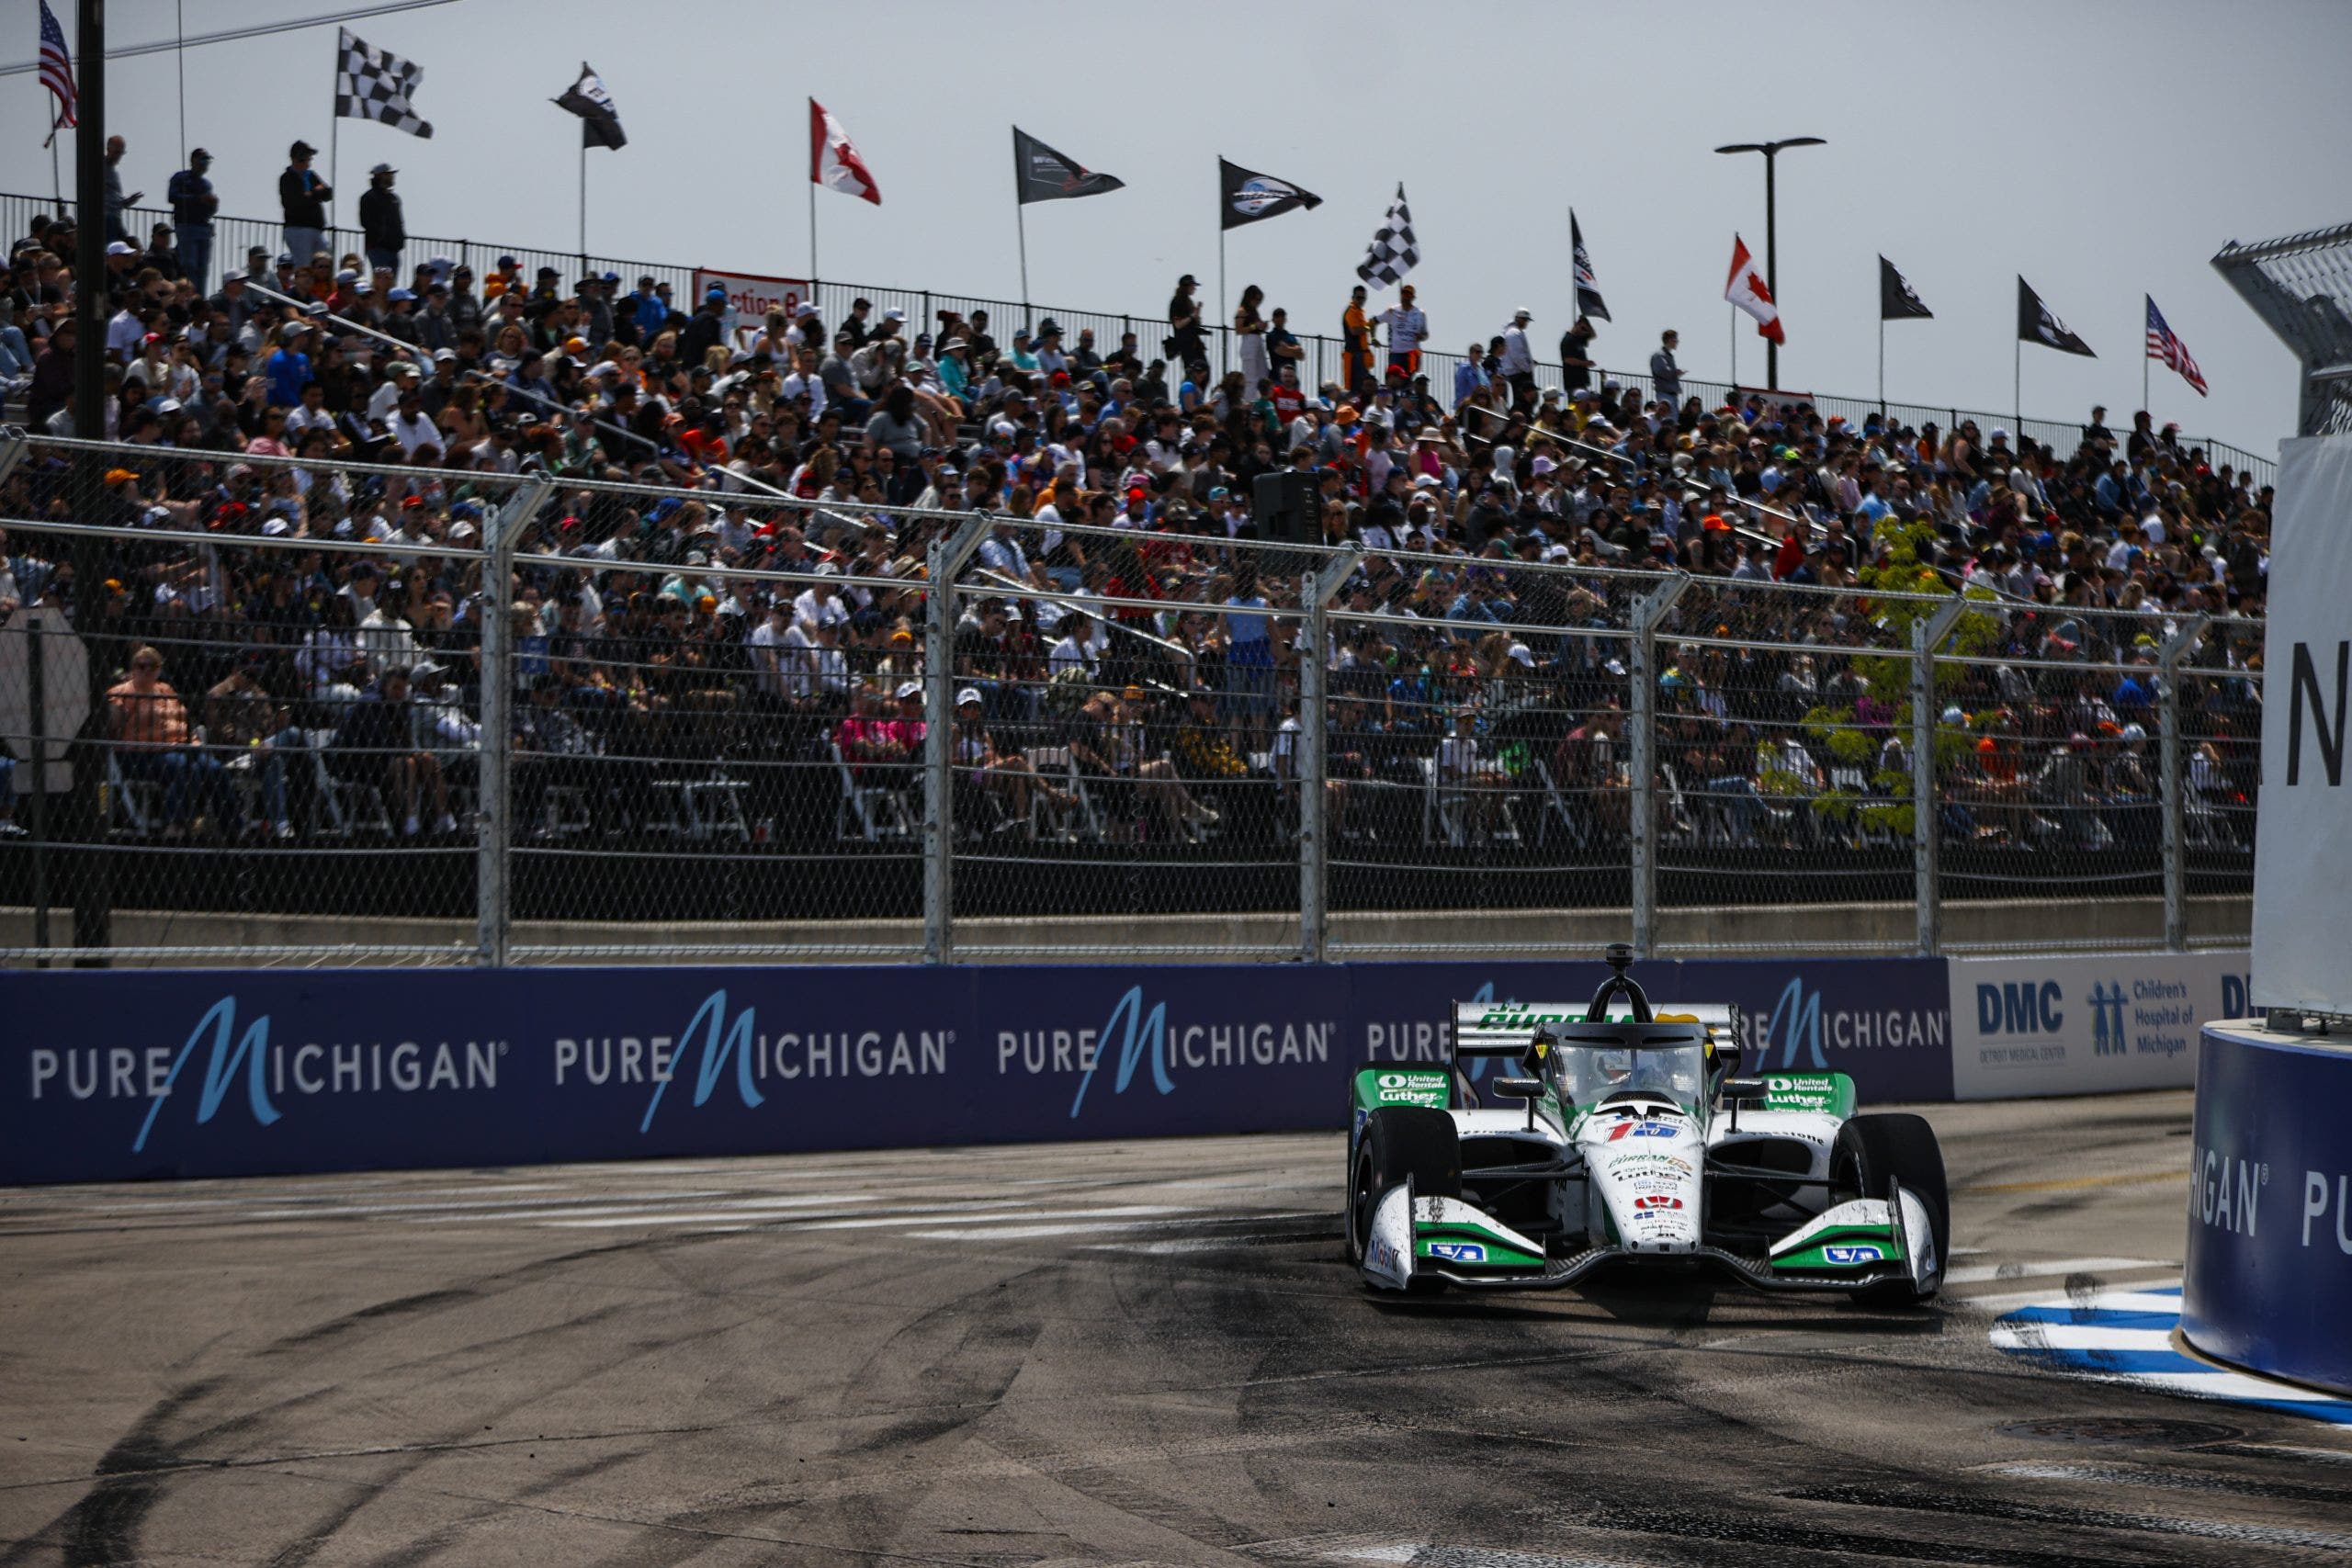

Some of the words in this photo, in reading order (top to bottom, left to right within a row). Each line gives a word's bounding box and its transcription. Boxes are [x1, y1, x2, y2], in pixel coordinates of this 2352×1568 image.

[2287, 641, 2349, 786] N
[1977, 978, 2064, 1035] DMC
[2132, 979, 2188, 999] Children's
[2135, 1007, 2180, 1028] Hospital
[2182, 1005, 2194, 1024] of
[555, 1036, 673, 1086] PURE
[998, 1028, 1098, 1074] PURE
[1367, 1021, 1451, 1061] PURE
[2137, 1035, 2187, 1057] Michigan
[31, 1046, 173, 1100] PURE
[2188, 1145, 2259, 1237] HIGAN
